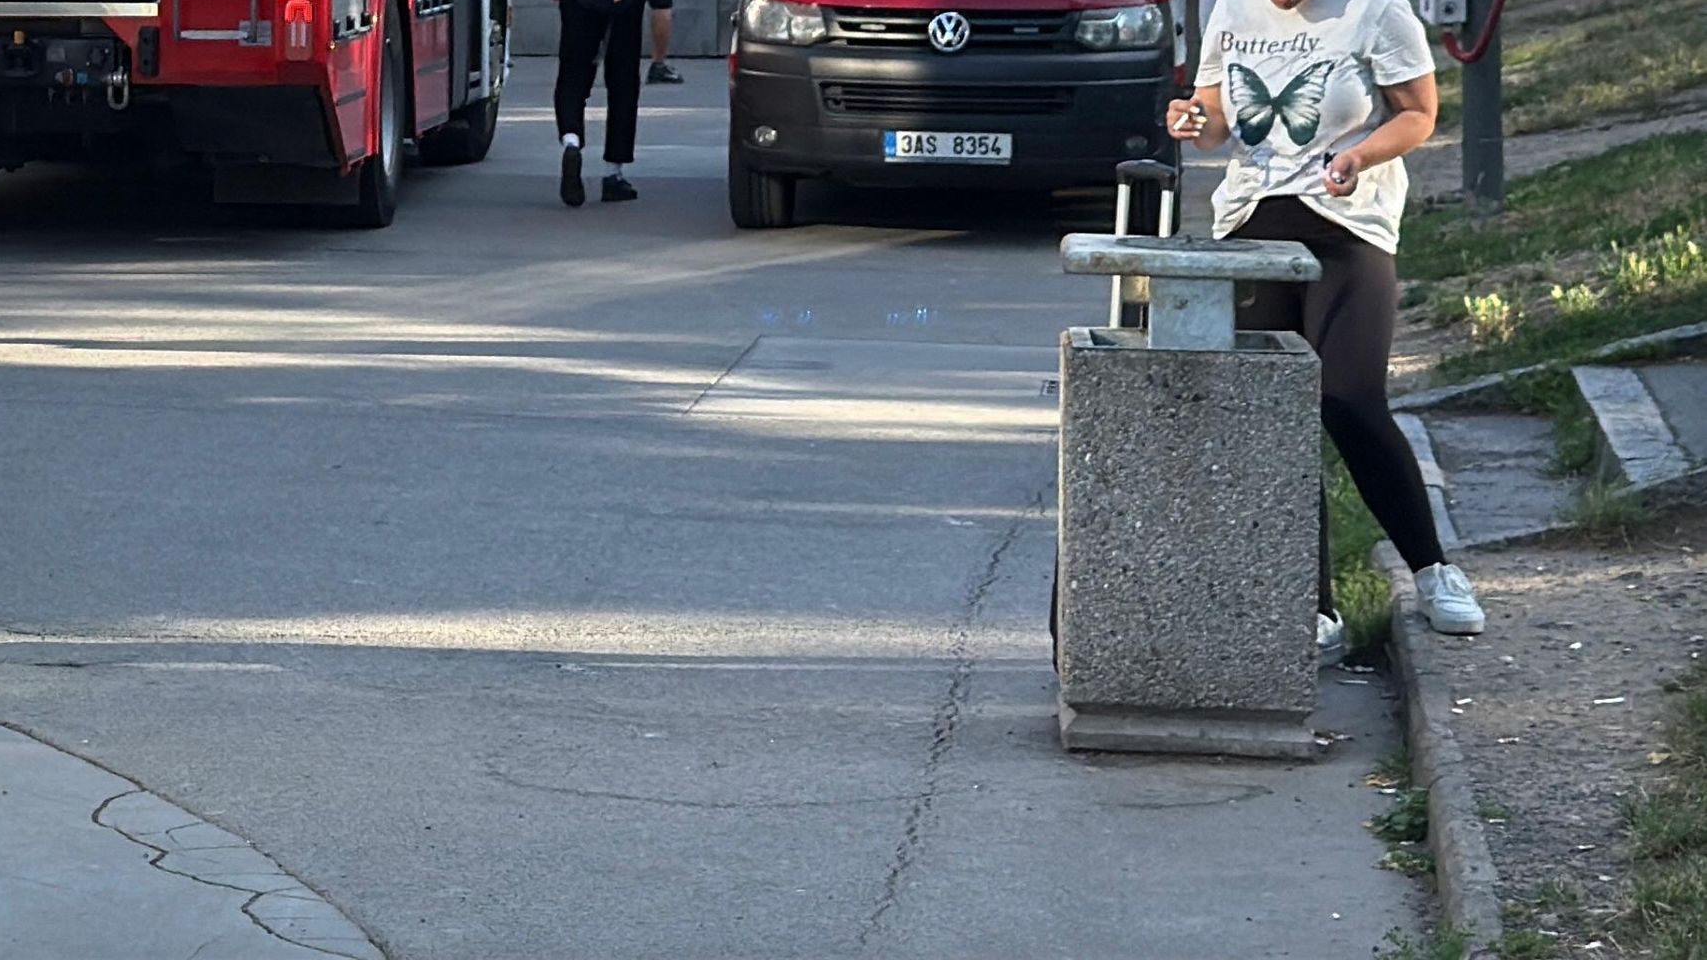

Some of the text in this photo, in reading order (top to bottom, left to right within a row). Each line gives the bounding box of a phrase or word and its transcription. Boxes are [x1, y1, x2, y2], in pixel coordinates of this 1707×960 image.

[1220, 31, 1321, 59] Butterfly
[901, 134, 1002, 156] 3AS 8354
